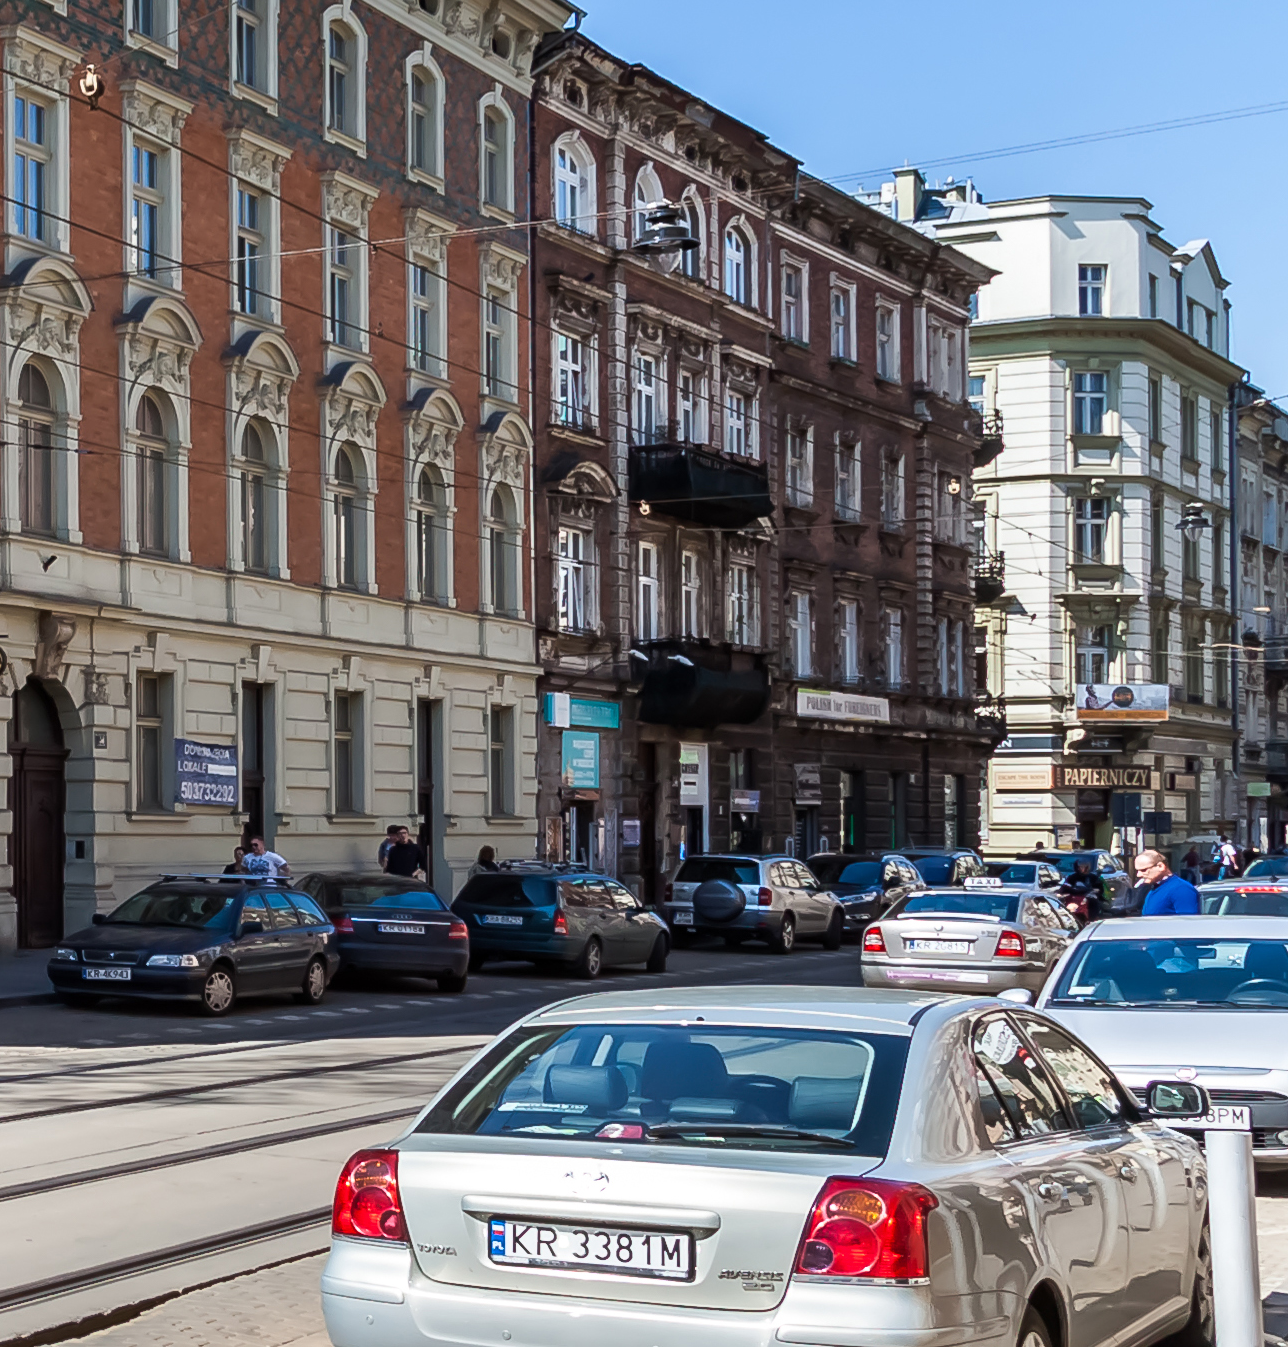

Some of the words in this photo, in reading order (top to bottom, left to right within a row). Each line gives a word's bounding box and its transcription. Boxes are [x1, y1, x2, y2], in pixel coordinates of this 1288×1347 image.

[806, 696, 832, 711] POLISH
[177, 760, 208, 773] LOKALE
[1064, 768, 1149, 786] PAPIERNICZY
[181, 781, 235, 802] 503732292
[914, 941, 931, 950] KR
[417, 1243, 458, 1257] TOYOTA
[492, 1241, 504, 1251] PL
[512, 1223, 557, 1257] KR
[572, 1229, 681, 1268] 3381M
